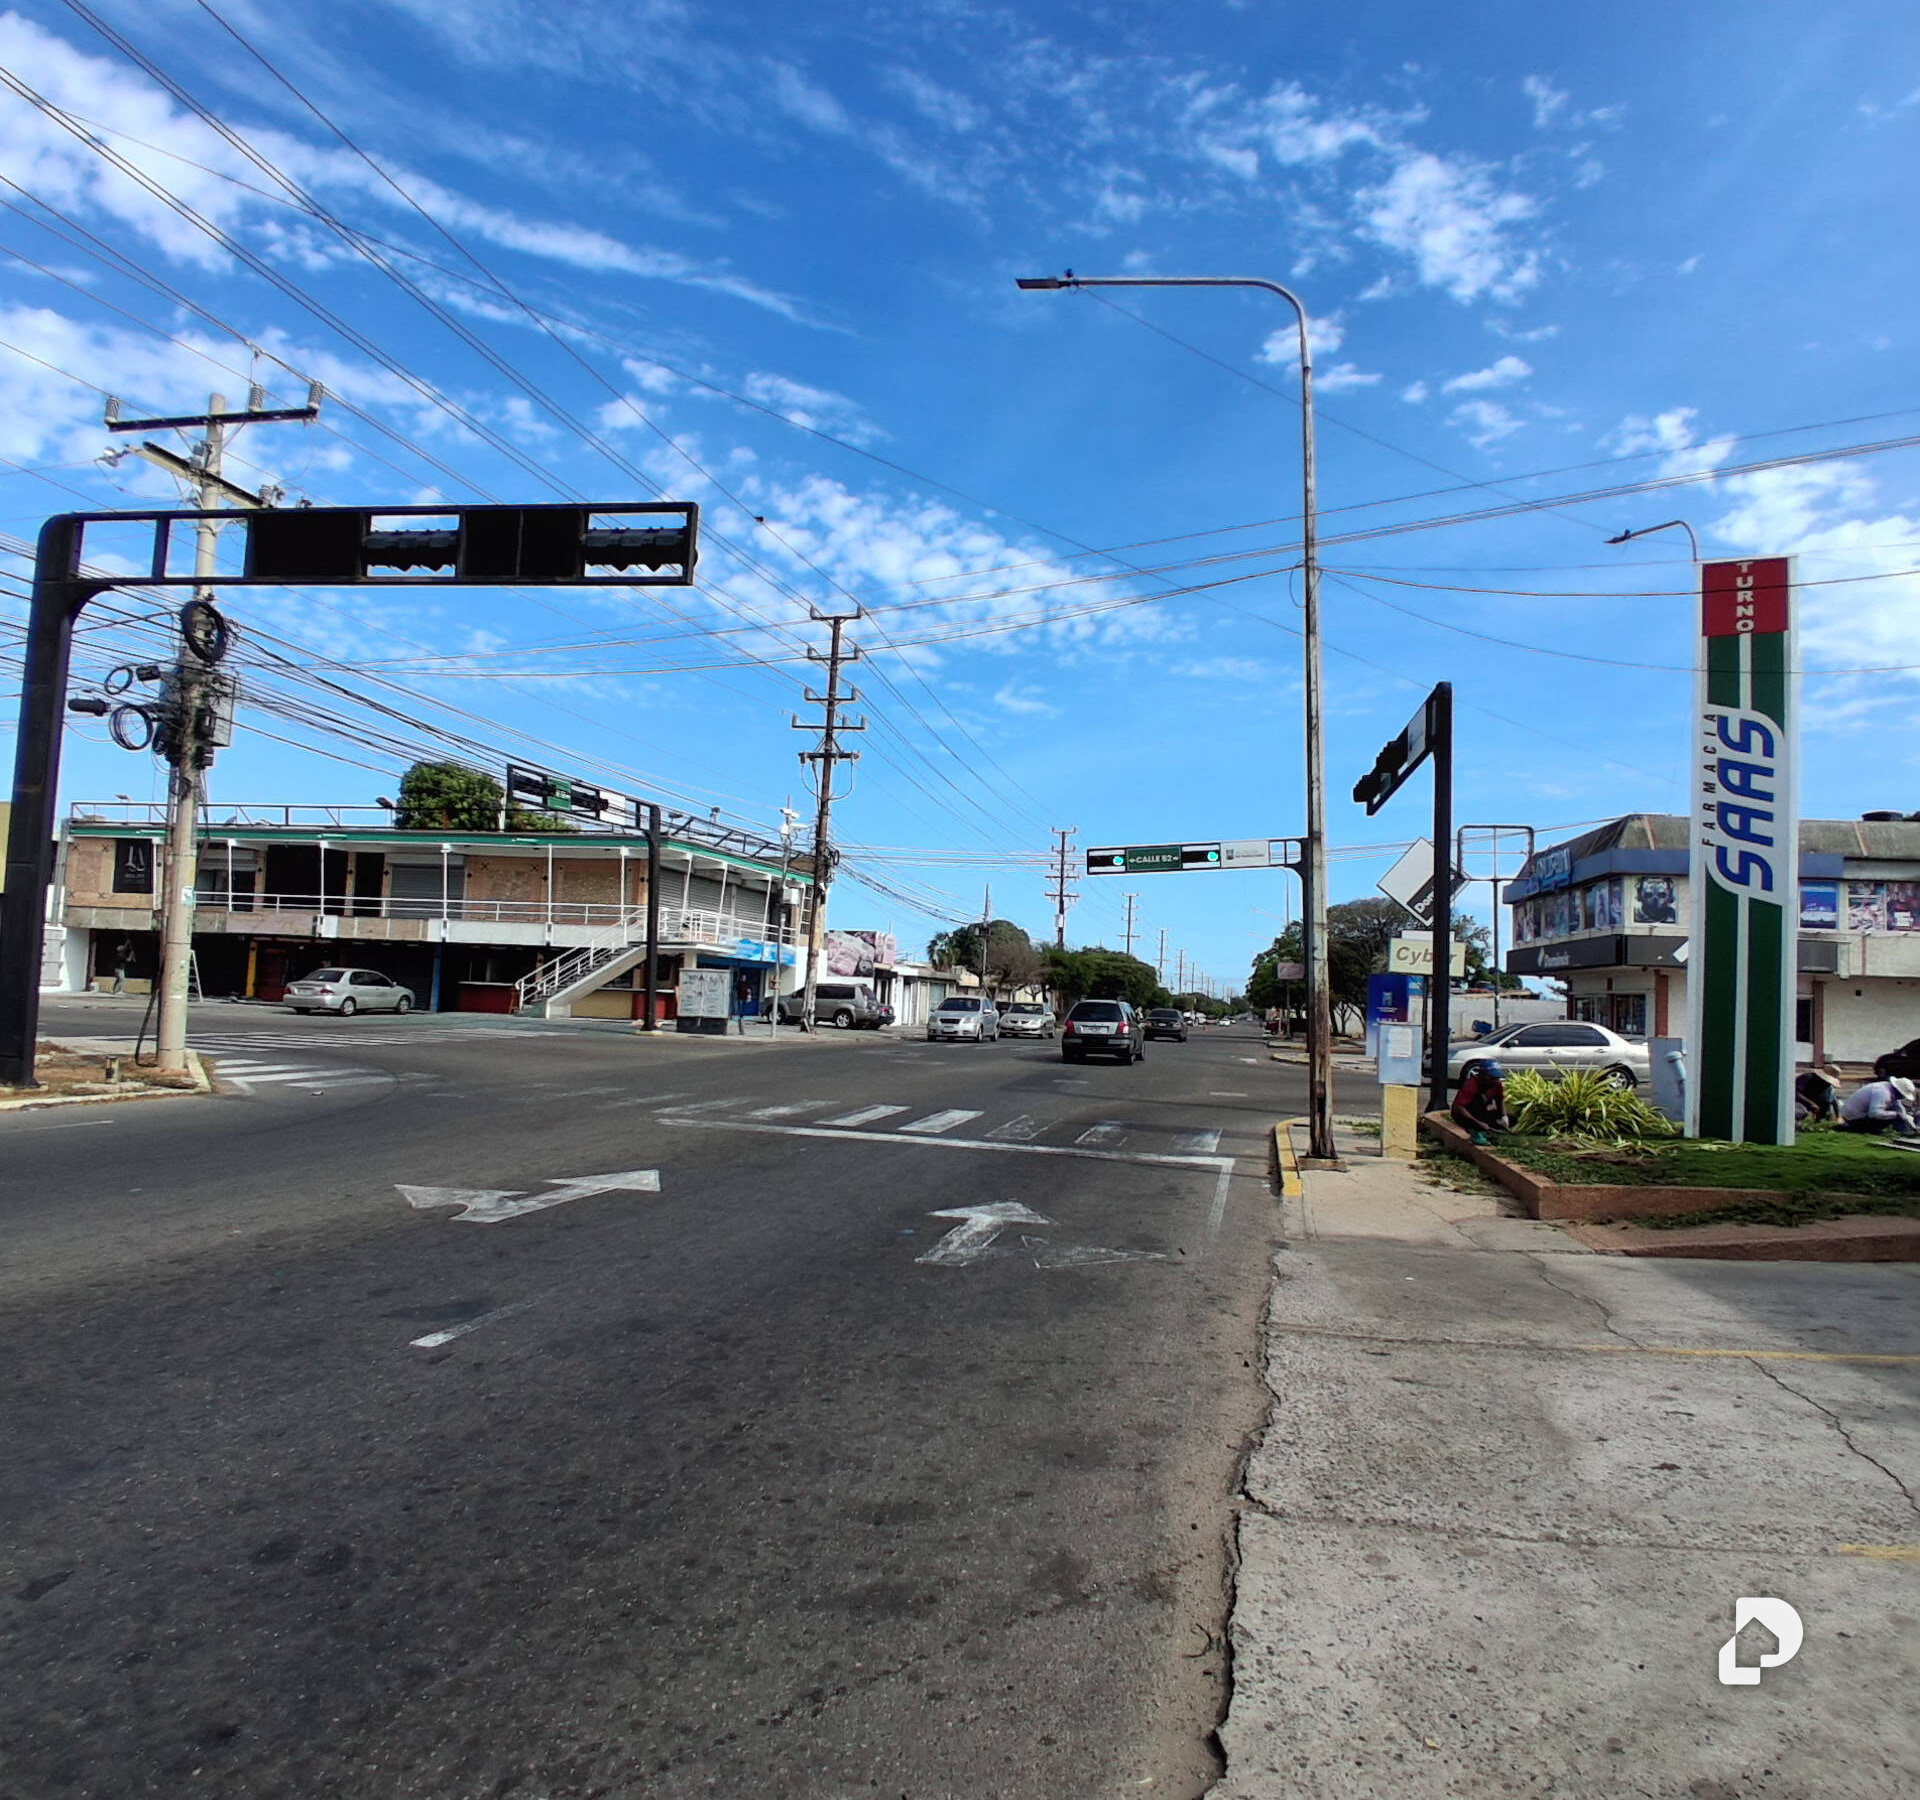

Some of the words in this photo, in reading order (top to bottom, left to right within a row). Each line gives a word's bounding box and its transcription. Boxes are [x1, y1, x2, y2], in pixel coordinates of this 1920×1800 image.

[1736, 561, 1754, 632] TURNO
[1702, 714, 1717, 847] FARMACIA
[1716, 714, 1774, 892] SAAS
[1136, 855, 1160, 863] CALLE
[1396, 946, 1457, 965] Cybr
